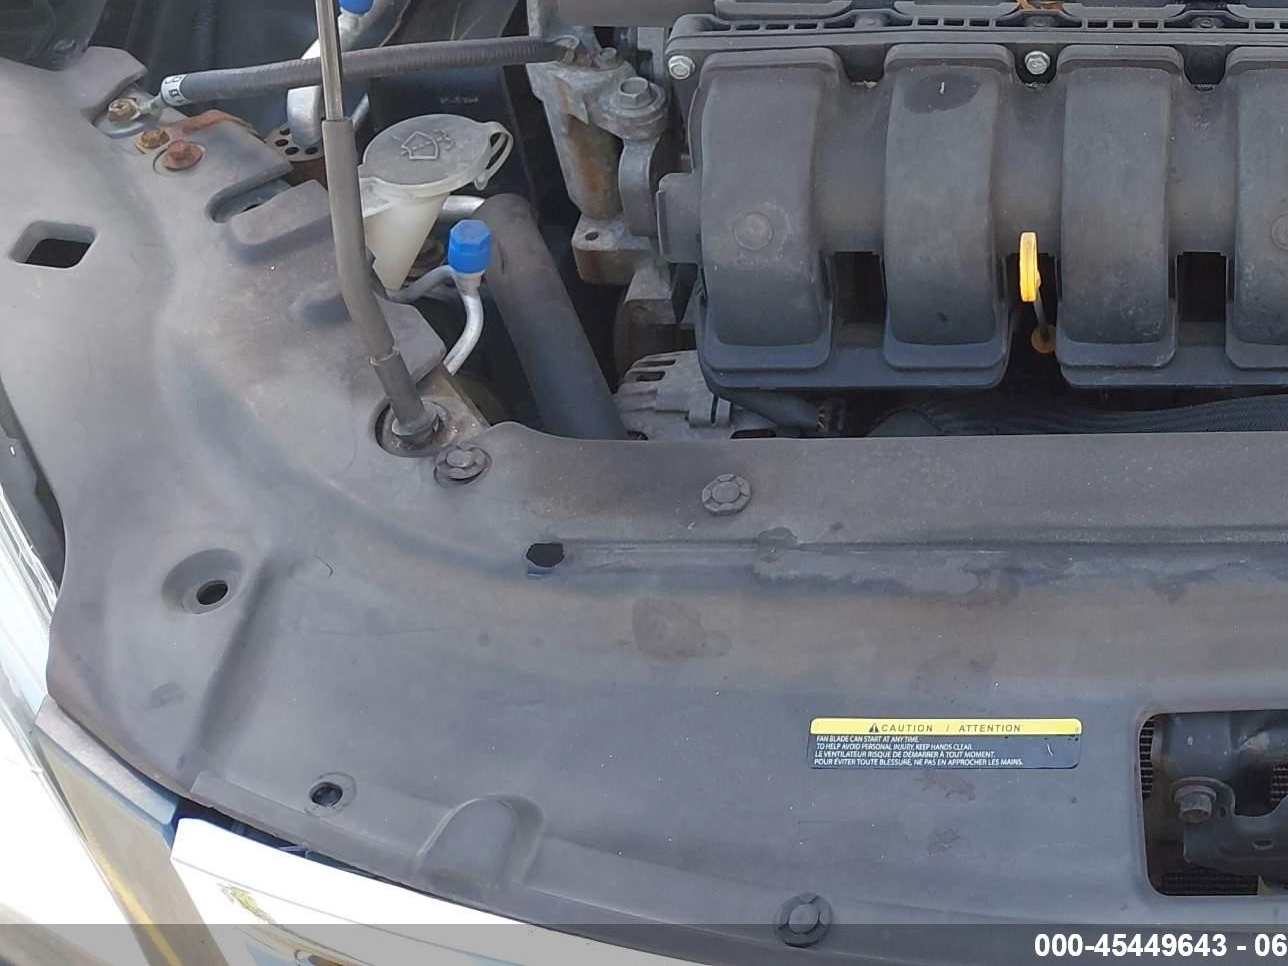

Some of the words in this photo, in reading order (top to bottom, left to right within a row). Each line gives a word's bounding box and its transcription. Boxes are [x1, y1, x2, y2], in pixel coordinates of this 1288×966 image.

[881, 724, 933, 732] CAUTION
[958, 724, 1021, 732] ATTENTION
[816, 735, 828, 743] FAN
[829, 735, 849, 743] BLADE
[850, 735, 863, 743] CAN
[864, 735, 881, 743] START
[882, 735, 890, 743] AT
[815, 750, 823, 758] LE
[823, 750, 867, 758] VENTILATEUR
[867, 750, 891, 758] RISQUE
[892, 750, 901, 758] DE
[945, 750, 963, 758] TOUT
